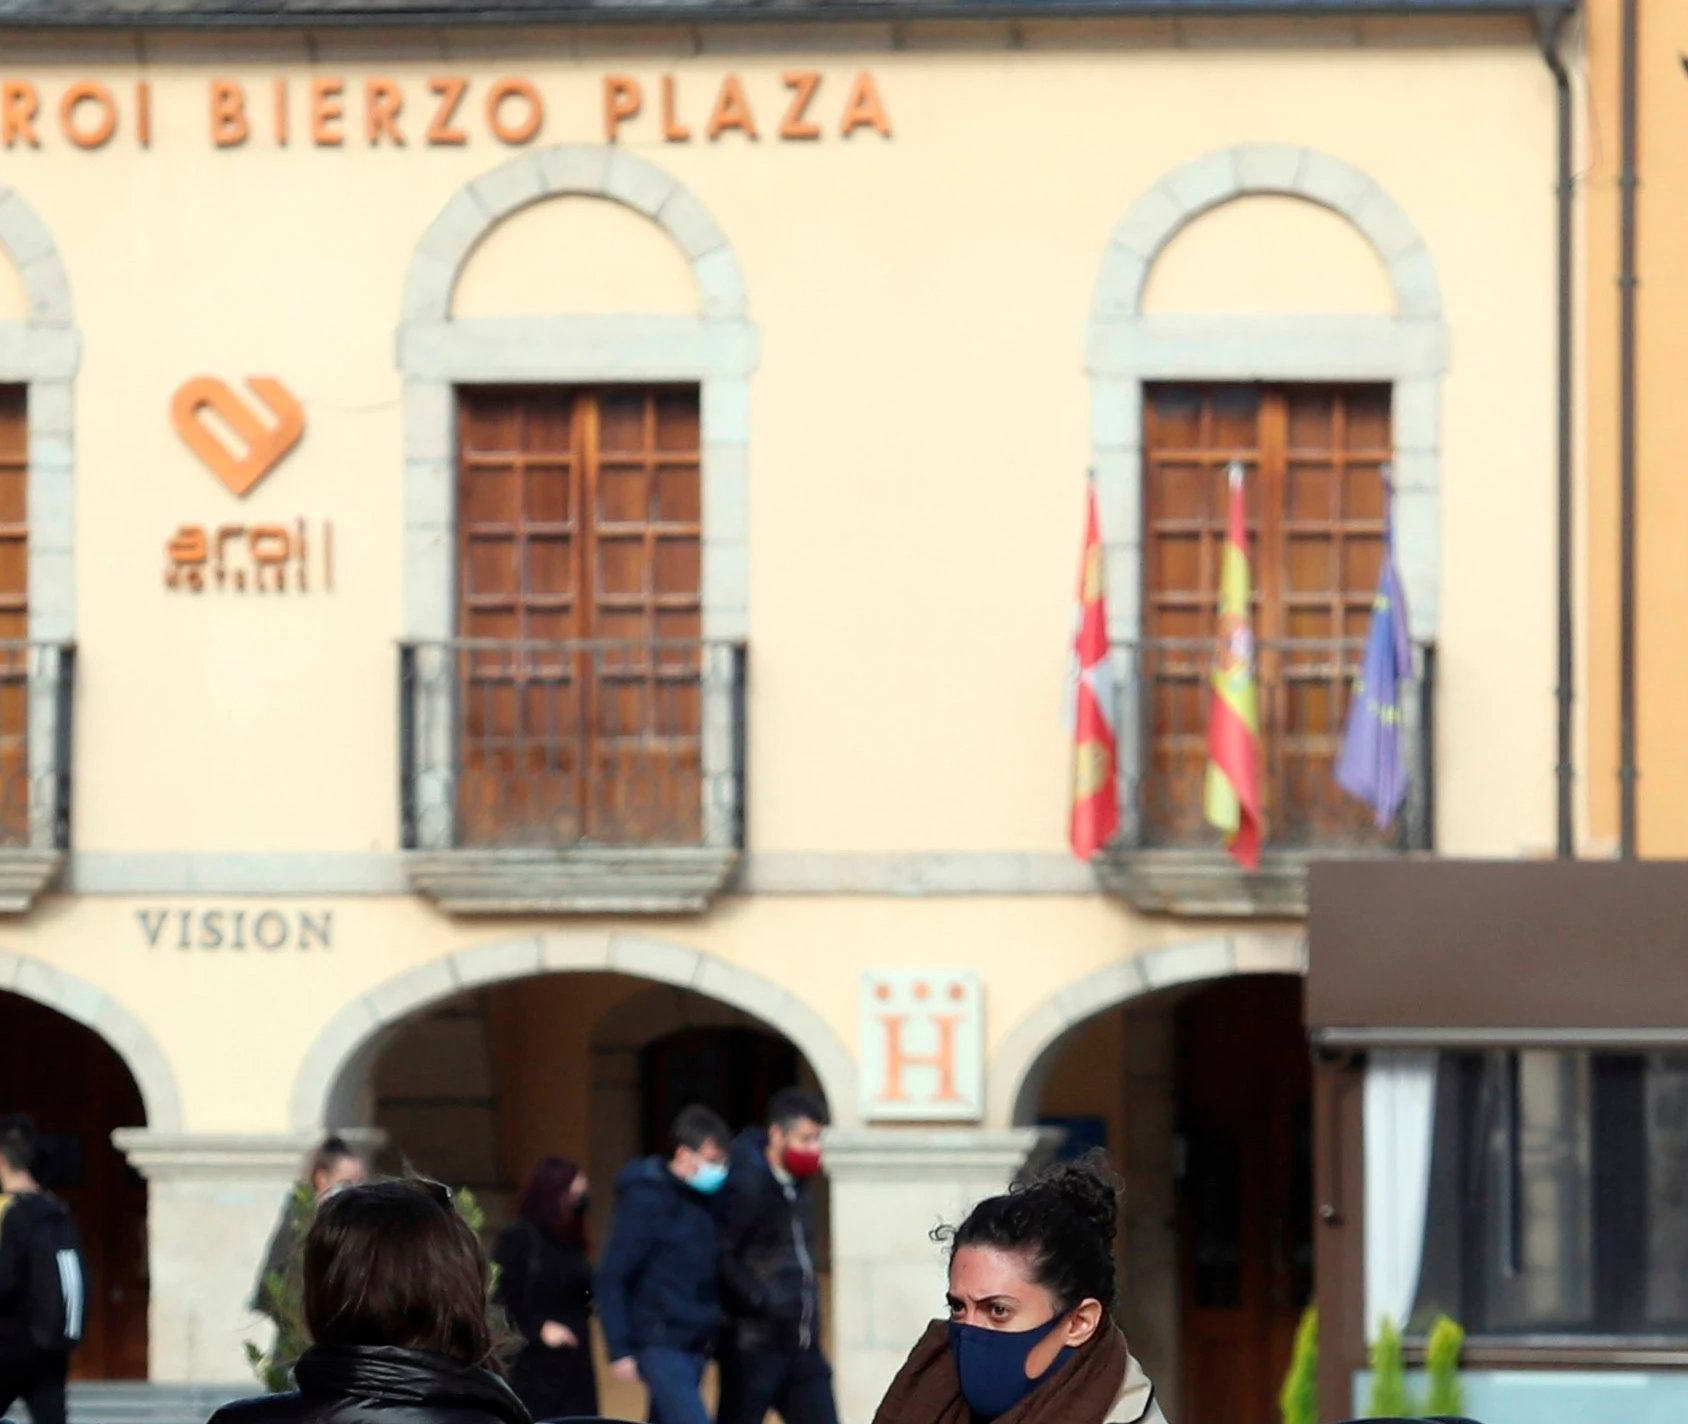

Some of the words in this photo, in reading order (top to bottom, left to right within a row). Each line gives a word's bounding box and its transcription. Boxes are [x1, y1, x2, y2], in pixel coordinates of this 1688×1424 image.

[210, 76, 545, 147] BIERZO
[602, 70, 892, 144] PLAZA
[136, 908, 333, 950] VISION
[876, 1012, 964, 1101] H
